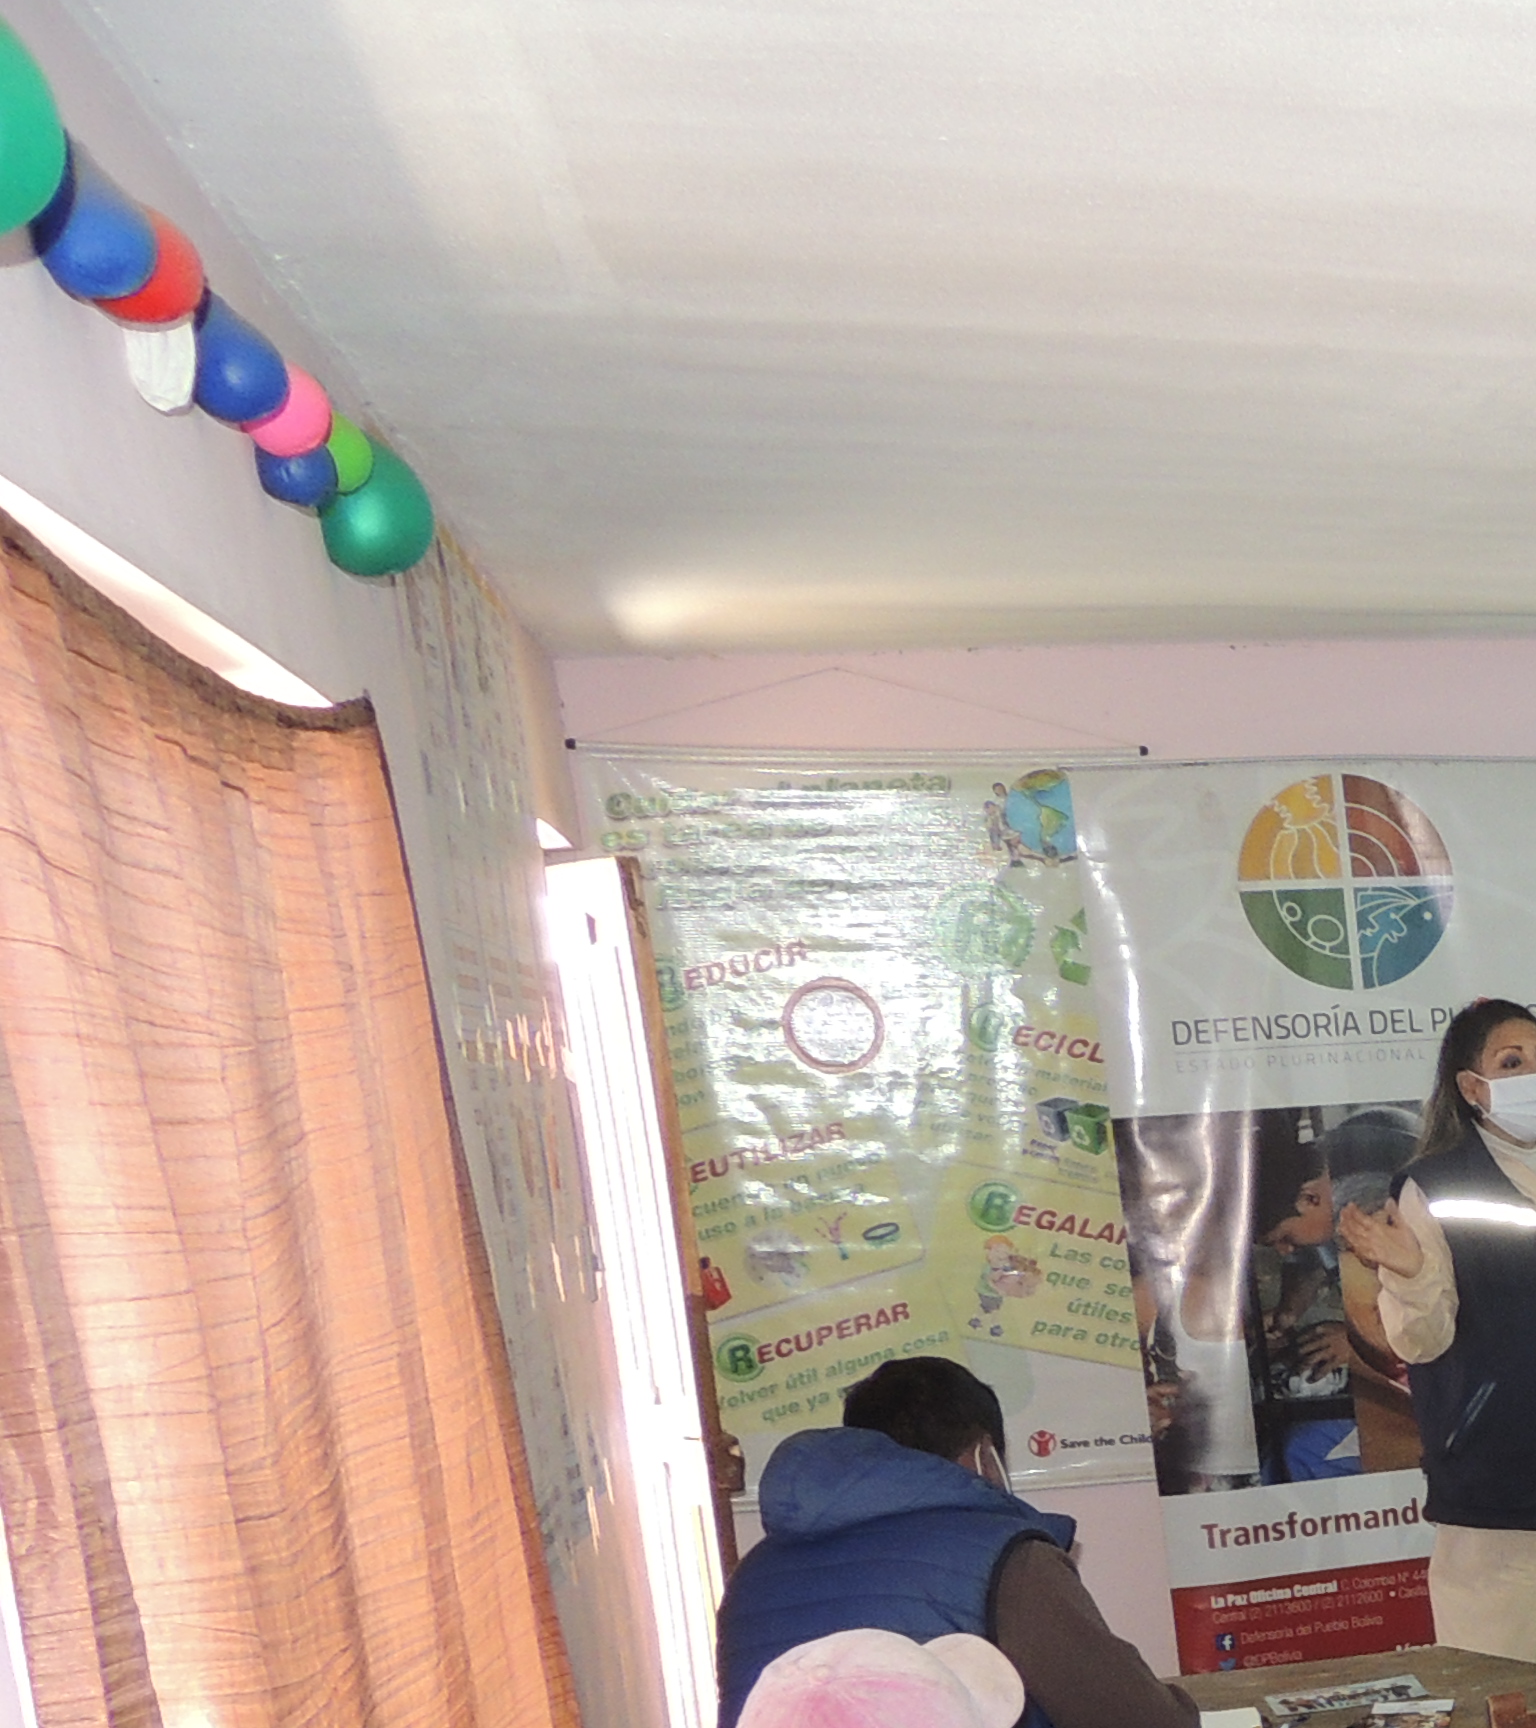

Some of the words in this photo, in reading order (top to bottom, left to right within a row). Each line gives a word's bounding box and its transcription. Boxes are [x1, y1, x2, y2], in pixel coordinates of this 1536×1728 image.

[1170, 1003, 1361, 1046] DEFENSORÍA
[1368, 1008, 1424, 1035] DEL
[1175, 1052, 1254, 1074] ESTADO
[1266, 1047, 1427, 1069] PLURINACIONAL
[1049, 1242, 1093, 1265] Las
[1099, 1255, 1130, 1272] co
[1046, 1270, 1092, 1293] que
[1103, 1281, 1133, 1298] se
[1066, 1297, 1134, 1324] útiles
[1031, 1319, 1089, 1342] para
[785, 1366, 818, 1391] útil
[825, 1346, 896, 1380] alguna
[902, 1329, 949, 1355] cosa
[761, 1400, 800, 1425] que
[1060, 1438, 1091, 1450] Save
[1094, 1435, 1117, 1447] the
[1210, 1595, 1226, 1609] La
[1227, 1591, 1248, 1607] Paz
[1249, 1586, 1292, 1604] Oficina
[1293, 1579, 1338, 1598] Central
[1296, 1622, 1313, 1635] del
[1314, 1619, 1349, 1634] Pueblo
[1351, 1614, 1384, 1629] Bolivia
